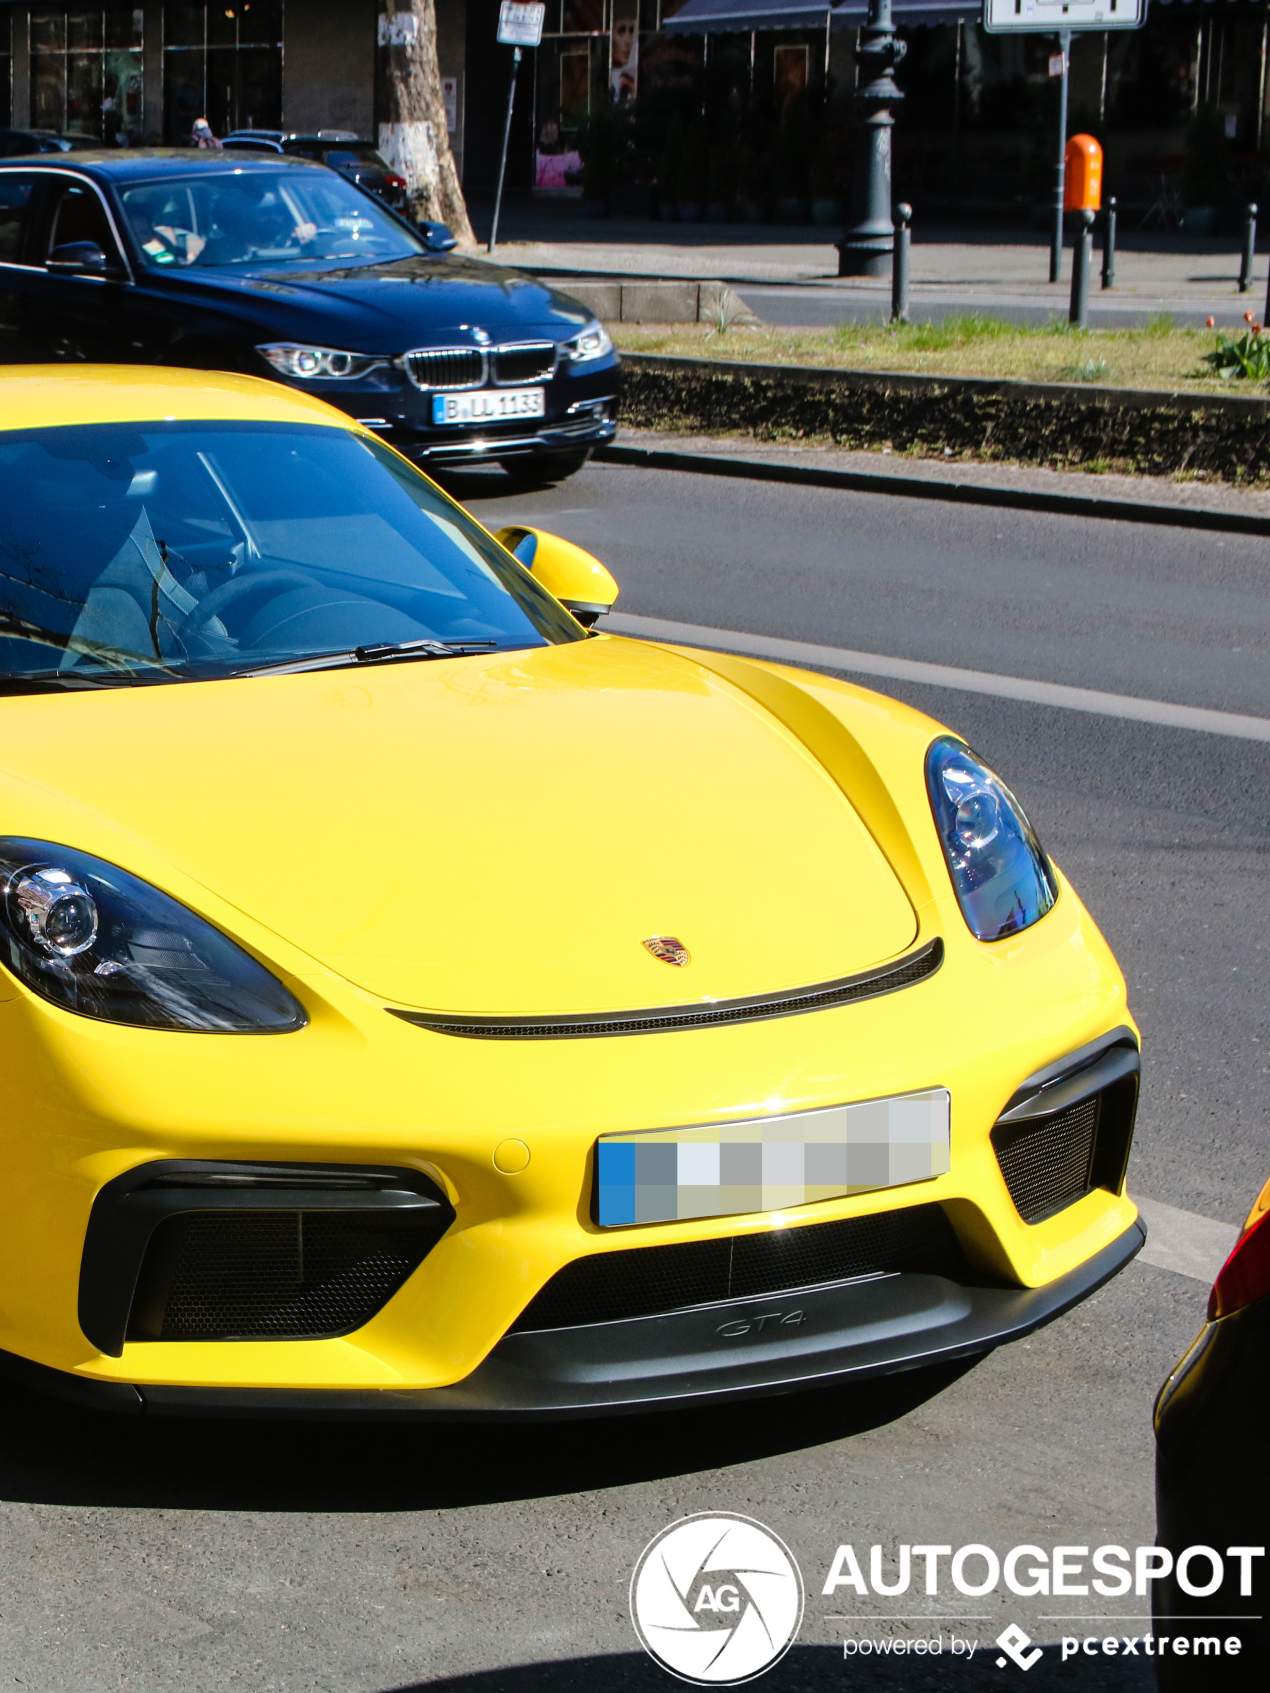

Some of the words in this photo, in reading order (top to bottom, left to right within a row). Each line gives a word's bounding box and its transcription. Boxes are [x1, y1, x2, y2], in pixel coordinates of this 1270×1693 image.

[447, 400, 458, 419] B
[499, 393, 540, 415] 1133
[716, 1310, 807, 1337] GT4
